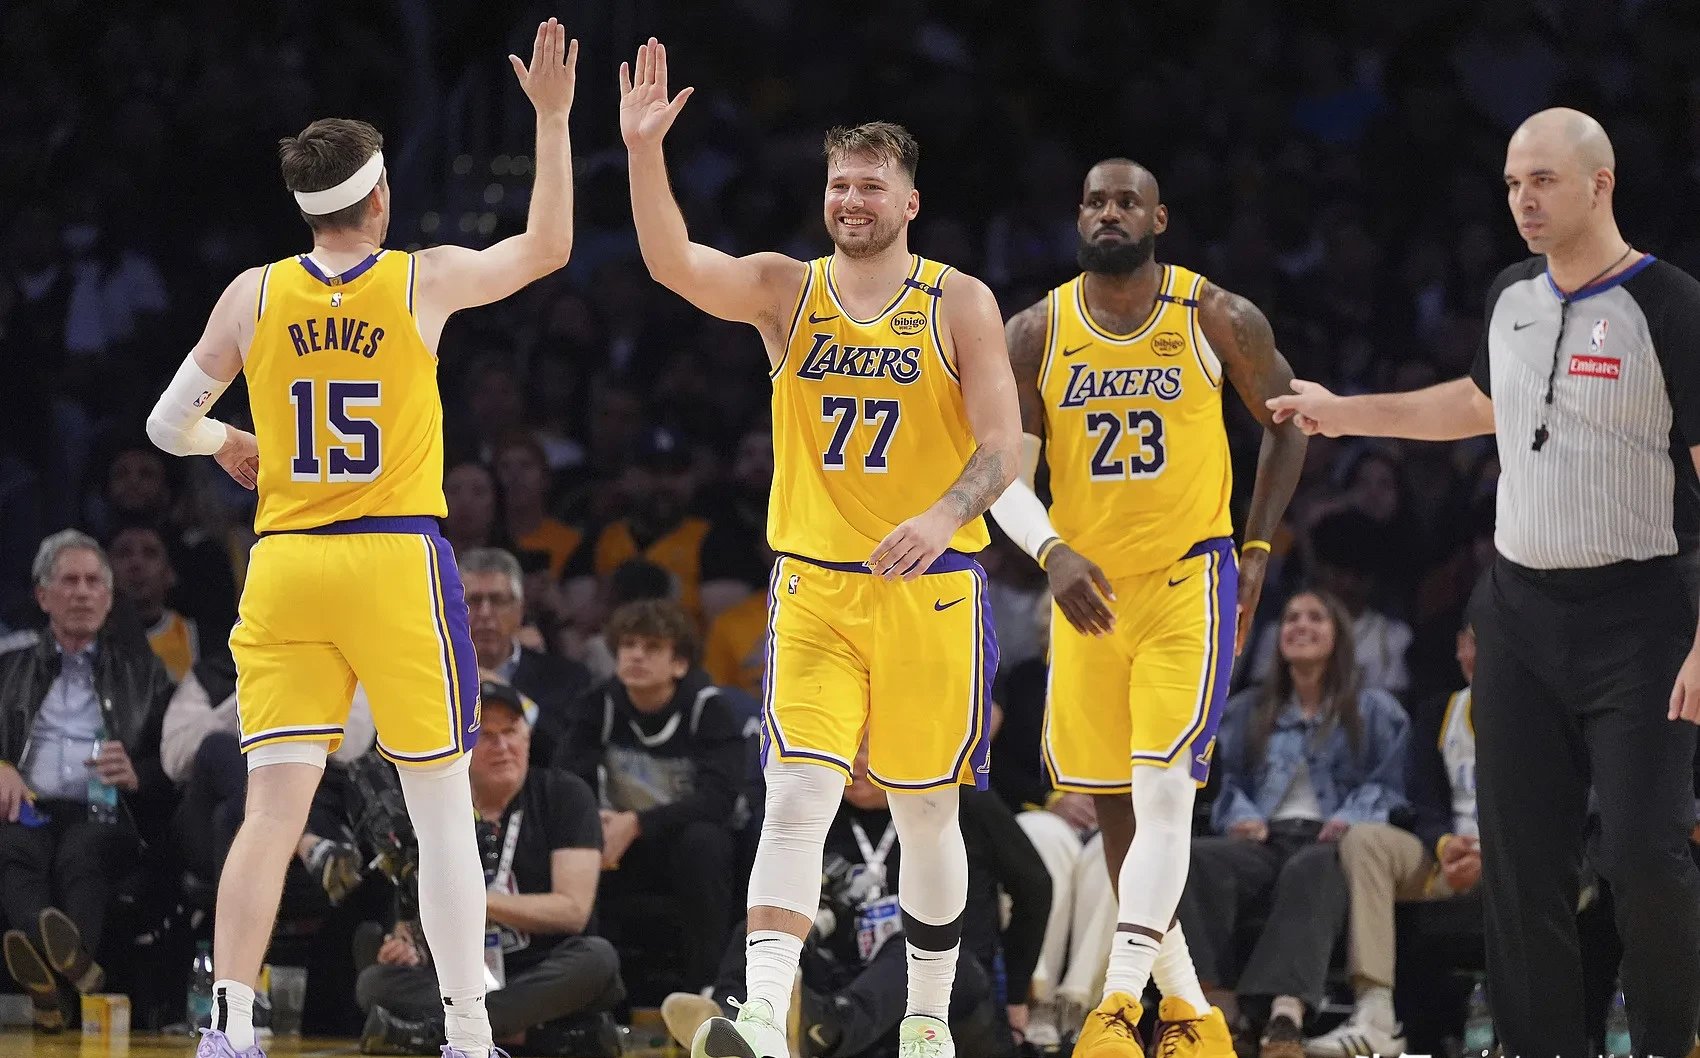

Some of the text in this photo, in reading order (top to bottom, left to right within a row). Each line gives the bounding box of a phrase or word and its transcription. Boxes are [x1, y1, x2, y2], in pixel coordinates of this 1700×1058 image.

[287, 317, 385, 359] REAVES
[894, 317, 925, 328] bibigo
[797, 333, 922, 386] LAKERS
[1570, 358, 1619, 376] Emirates
[1058, 364, 1184, 411] LAKERS
[289, 378, 382, 483] 15
[821, 394, 900, 474] 77
[1085, 409, 1168, 483] 23
